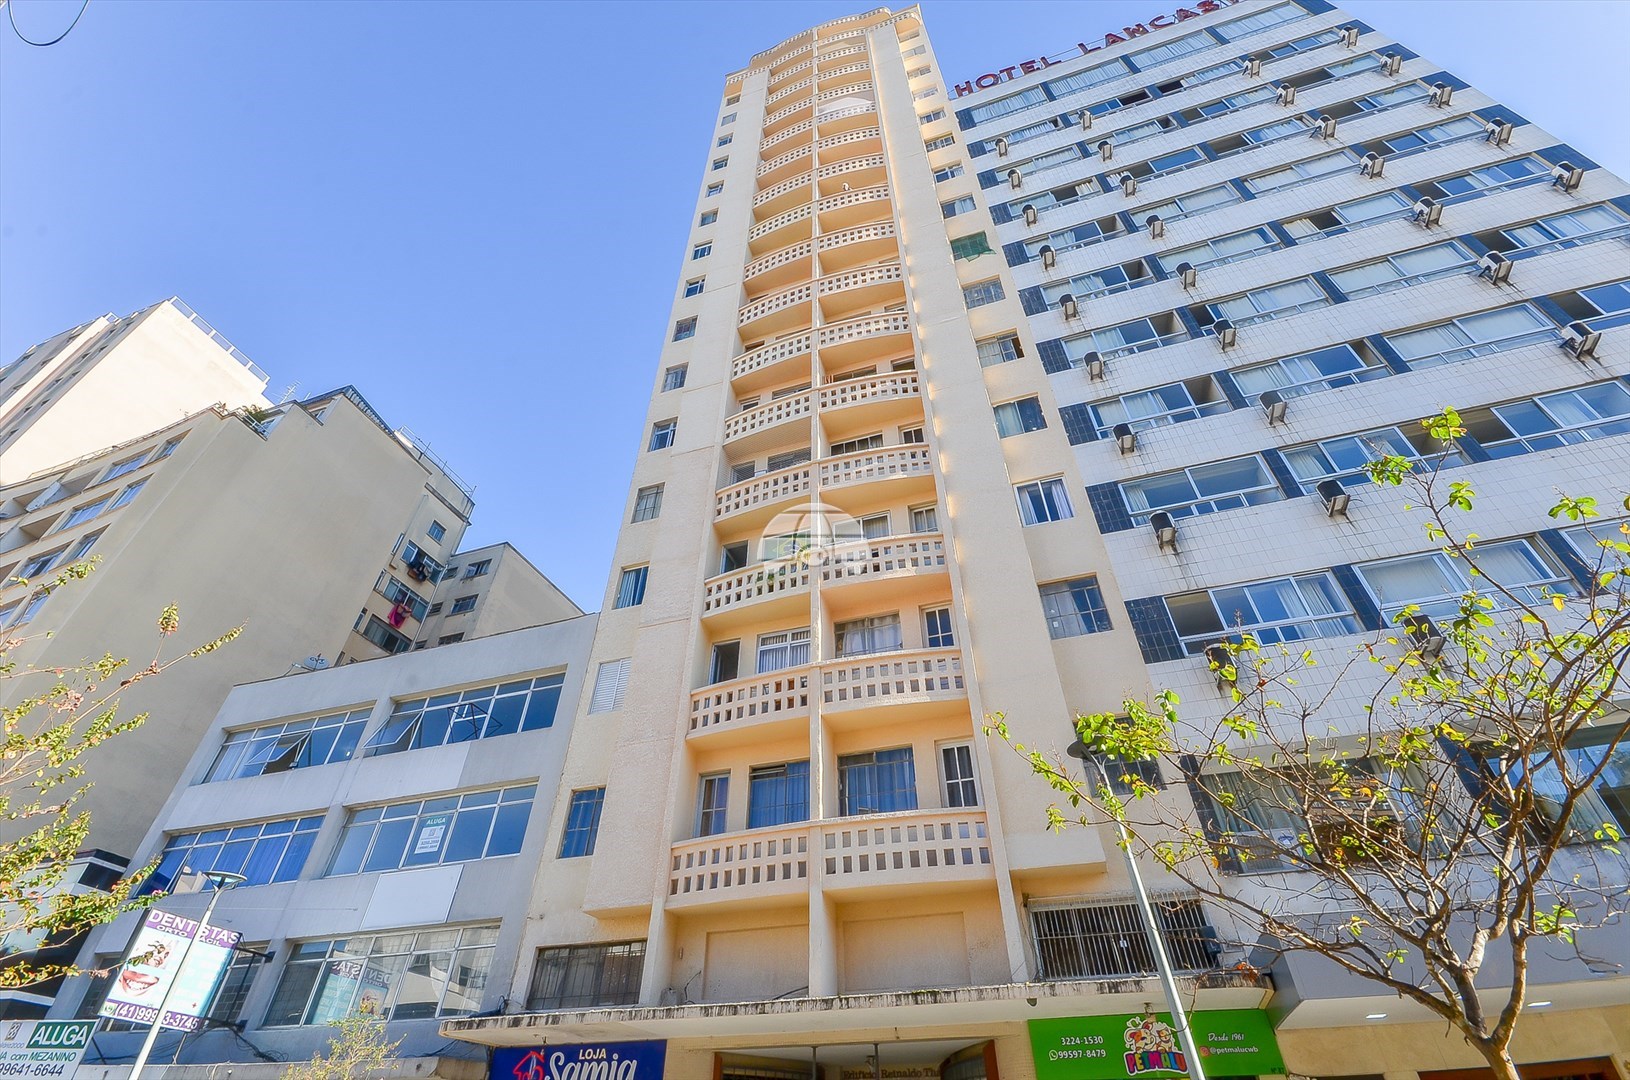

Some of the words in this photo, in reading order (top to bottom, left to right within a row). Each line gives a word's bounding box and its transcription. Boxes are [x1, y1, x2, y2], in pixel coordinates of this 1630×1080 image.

[954, 56, 1062, 98] HOTEL
[426, 817, 446, 826] ALUGA
[156, 925, 188, 937] ORTO
[115, 1003, 200, 1030] (41)9993-3745
[30, 1025, 88, 1046] ALUGA
[1061, 1036, 1104, 1046] 3224-1530
[1208, 1033, 1229, 1042] Desde
[1231, 1033, 1245, 1041] 1961
[10, 1053, 28, 1061] com
[28, 1051, 77, 1062] MEZANINO
[579, 1048, 607, 1060] LOJA
[1058, 1049, 1107, 1059] 99597-8479
[1210, 1046, 1259, 1055] @petmalucwb
[1125, 1051, 1188, 1074] PETMALU
[881, 1067, 922, 1079] Reinaldo
